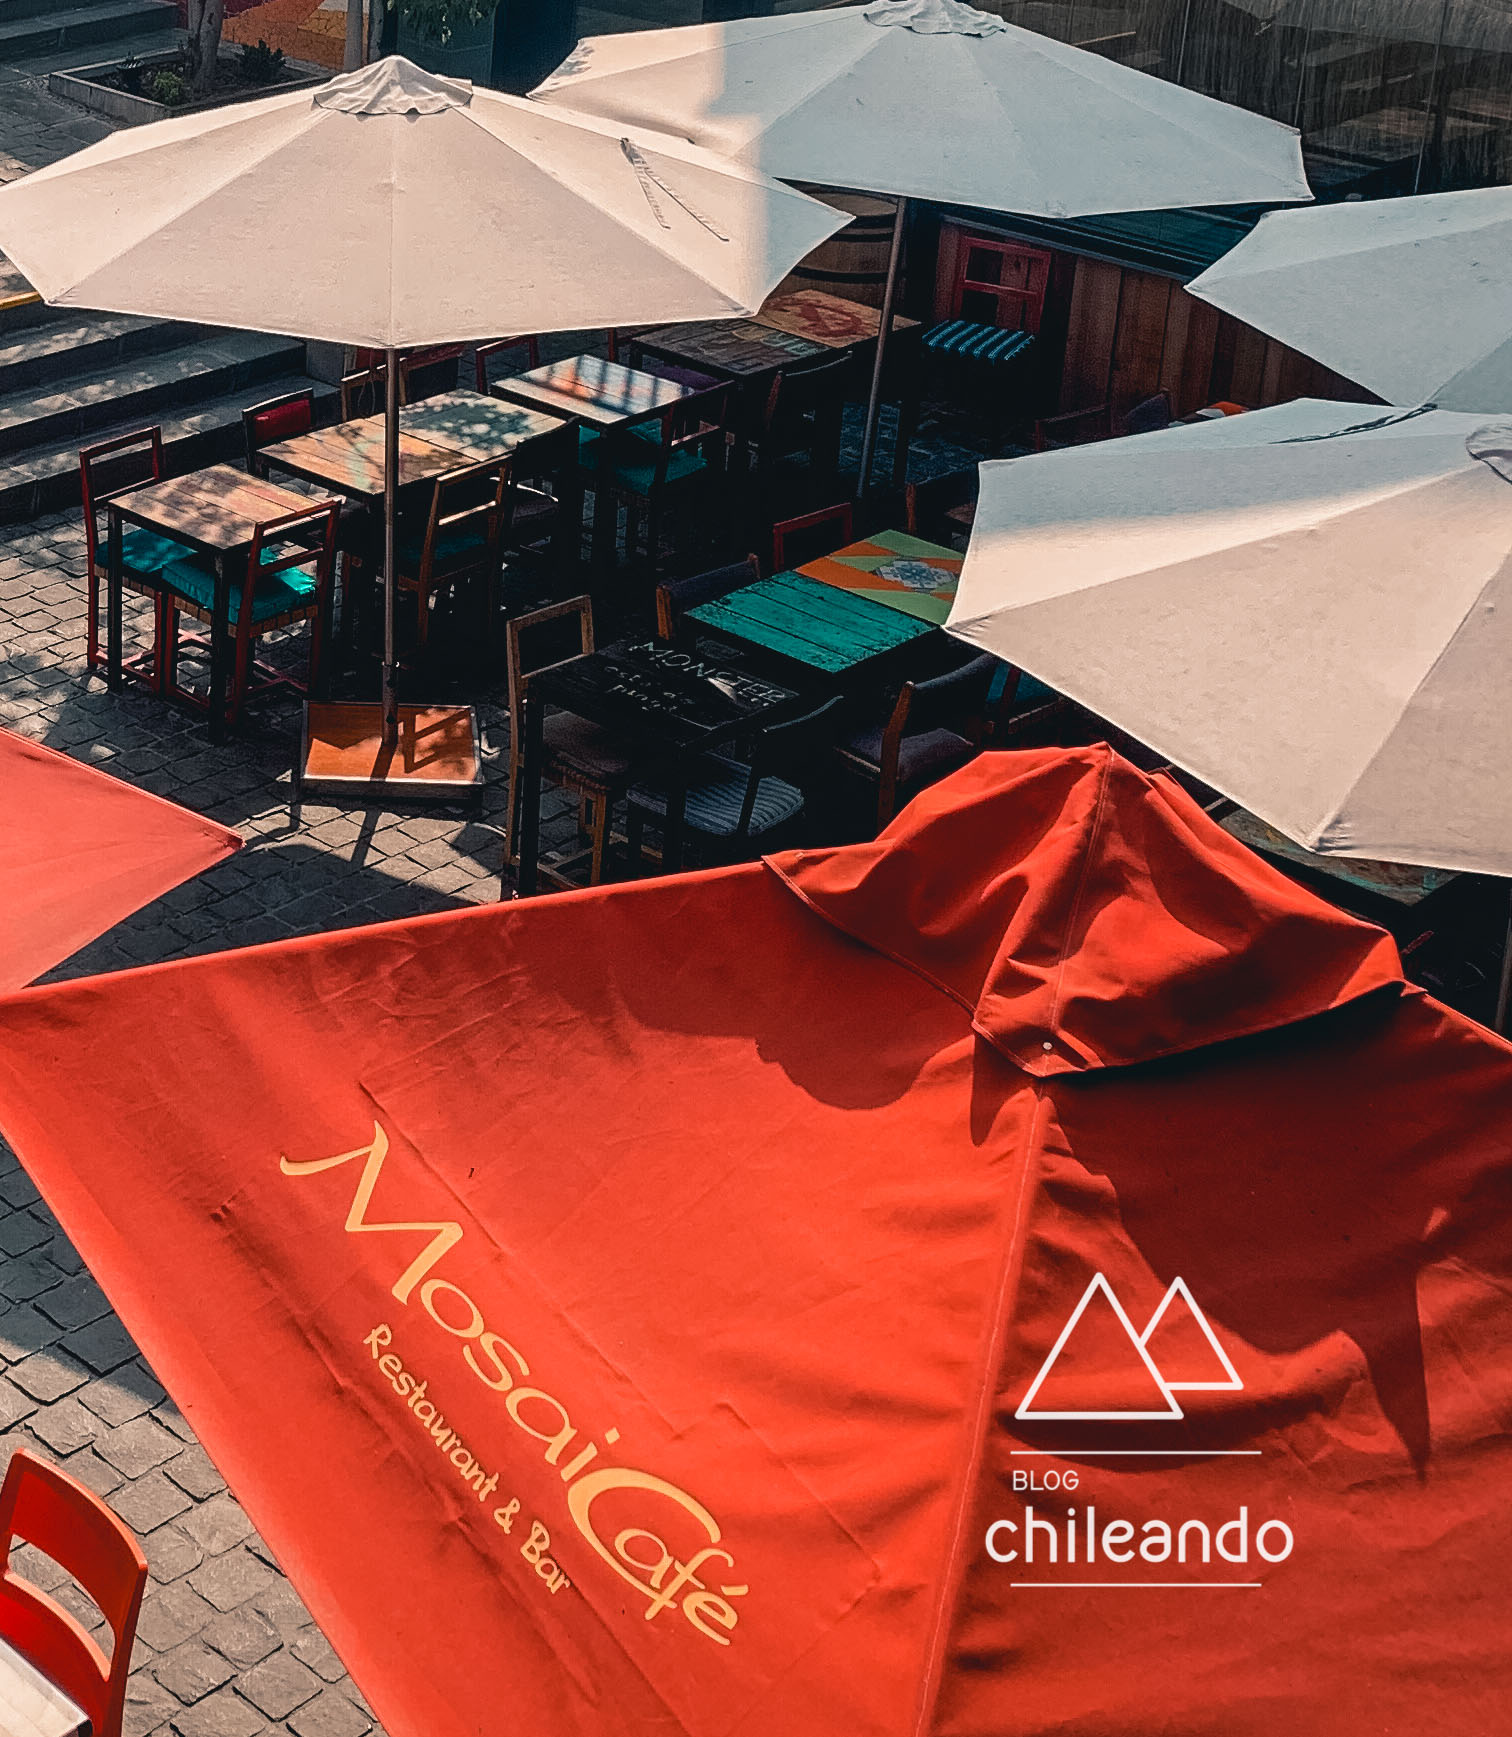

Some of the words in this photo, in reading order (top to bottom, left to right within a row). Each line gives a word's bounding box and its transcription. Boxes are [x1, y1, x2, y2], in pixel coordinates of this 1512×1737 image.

[362, 1324, 500, 1502] Restaurant
[493, 1497, 522, 1534] &
[519, 1519, 571, 1595] Bar
